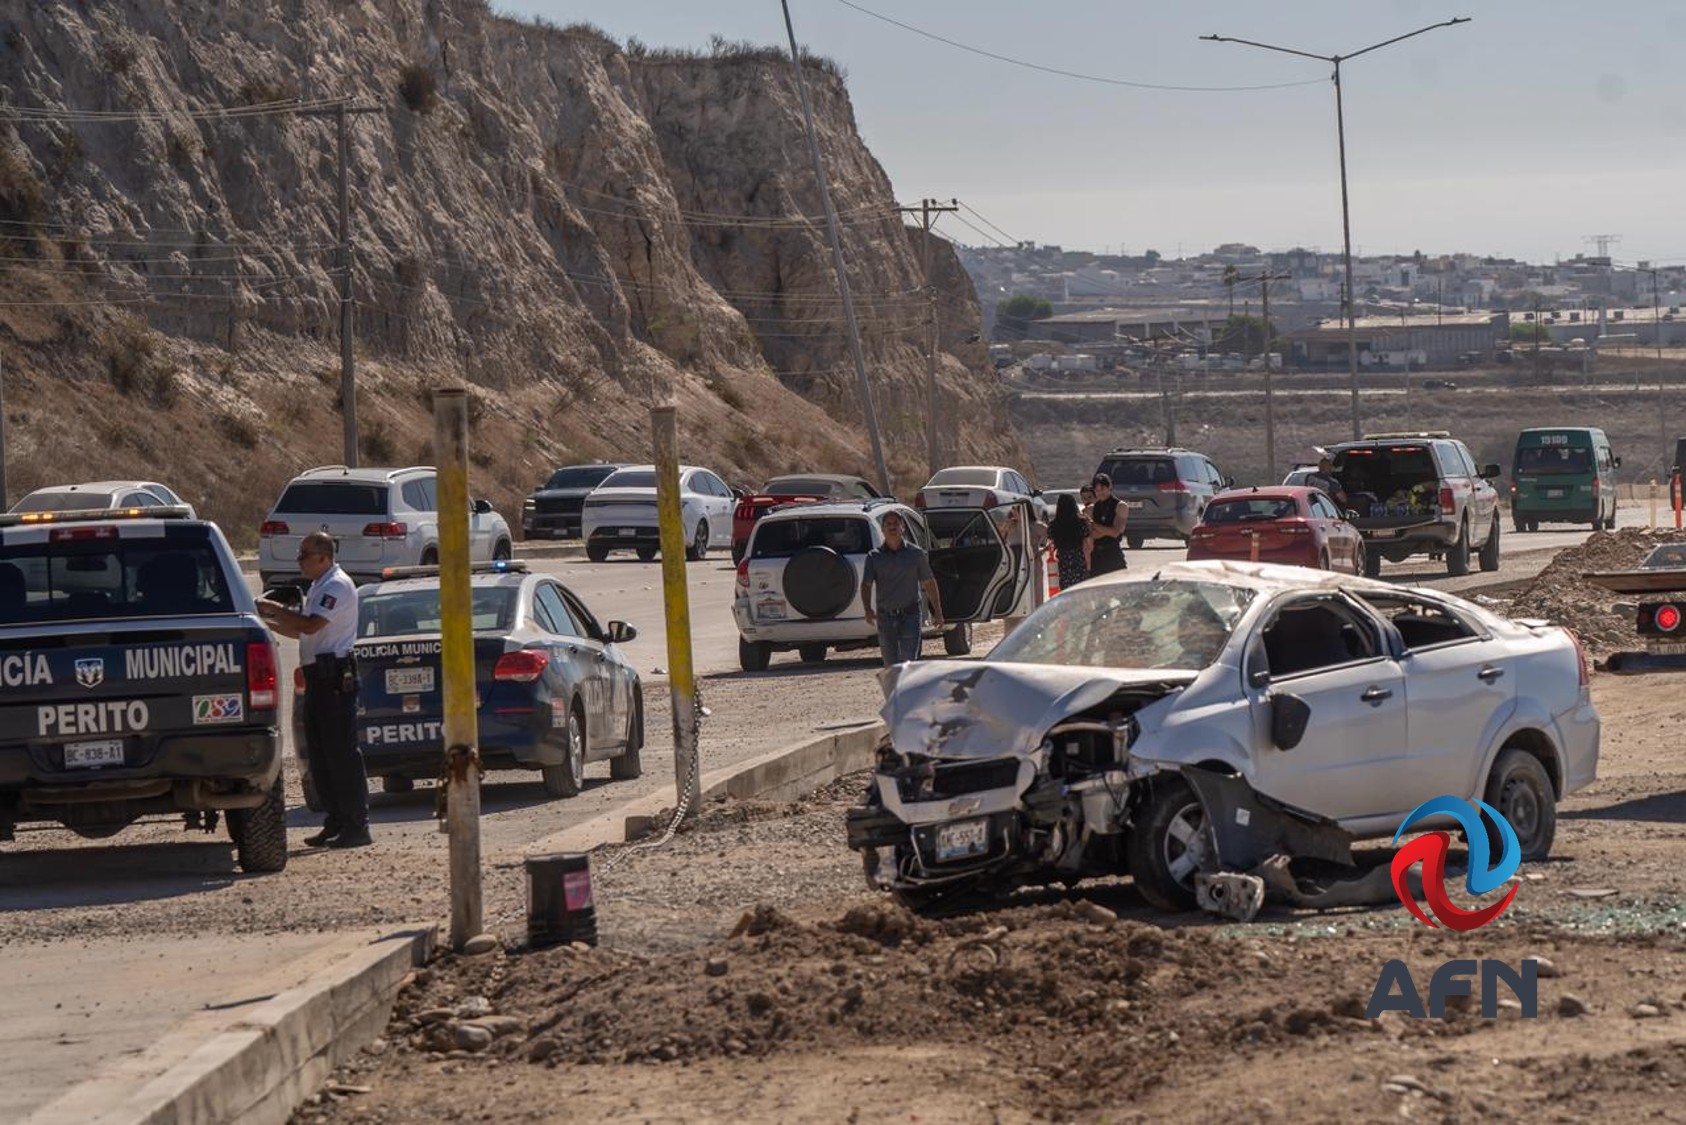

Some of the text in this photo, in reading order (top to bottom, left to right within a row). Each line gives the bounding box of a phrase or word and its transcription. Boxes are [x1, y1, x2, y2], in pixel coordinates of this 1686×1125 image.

[401, 642, 442, 656] MUNIC
[0, 643, 241, 687] CÍA MUNICIPAL
[38, 701, 149, 736] PERITO
[197, 697, 240, 718] 089
[366, 722, 447, 744] PERIT
